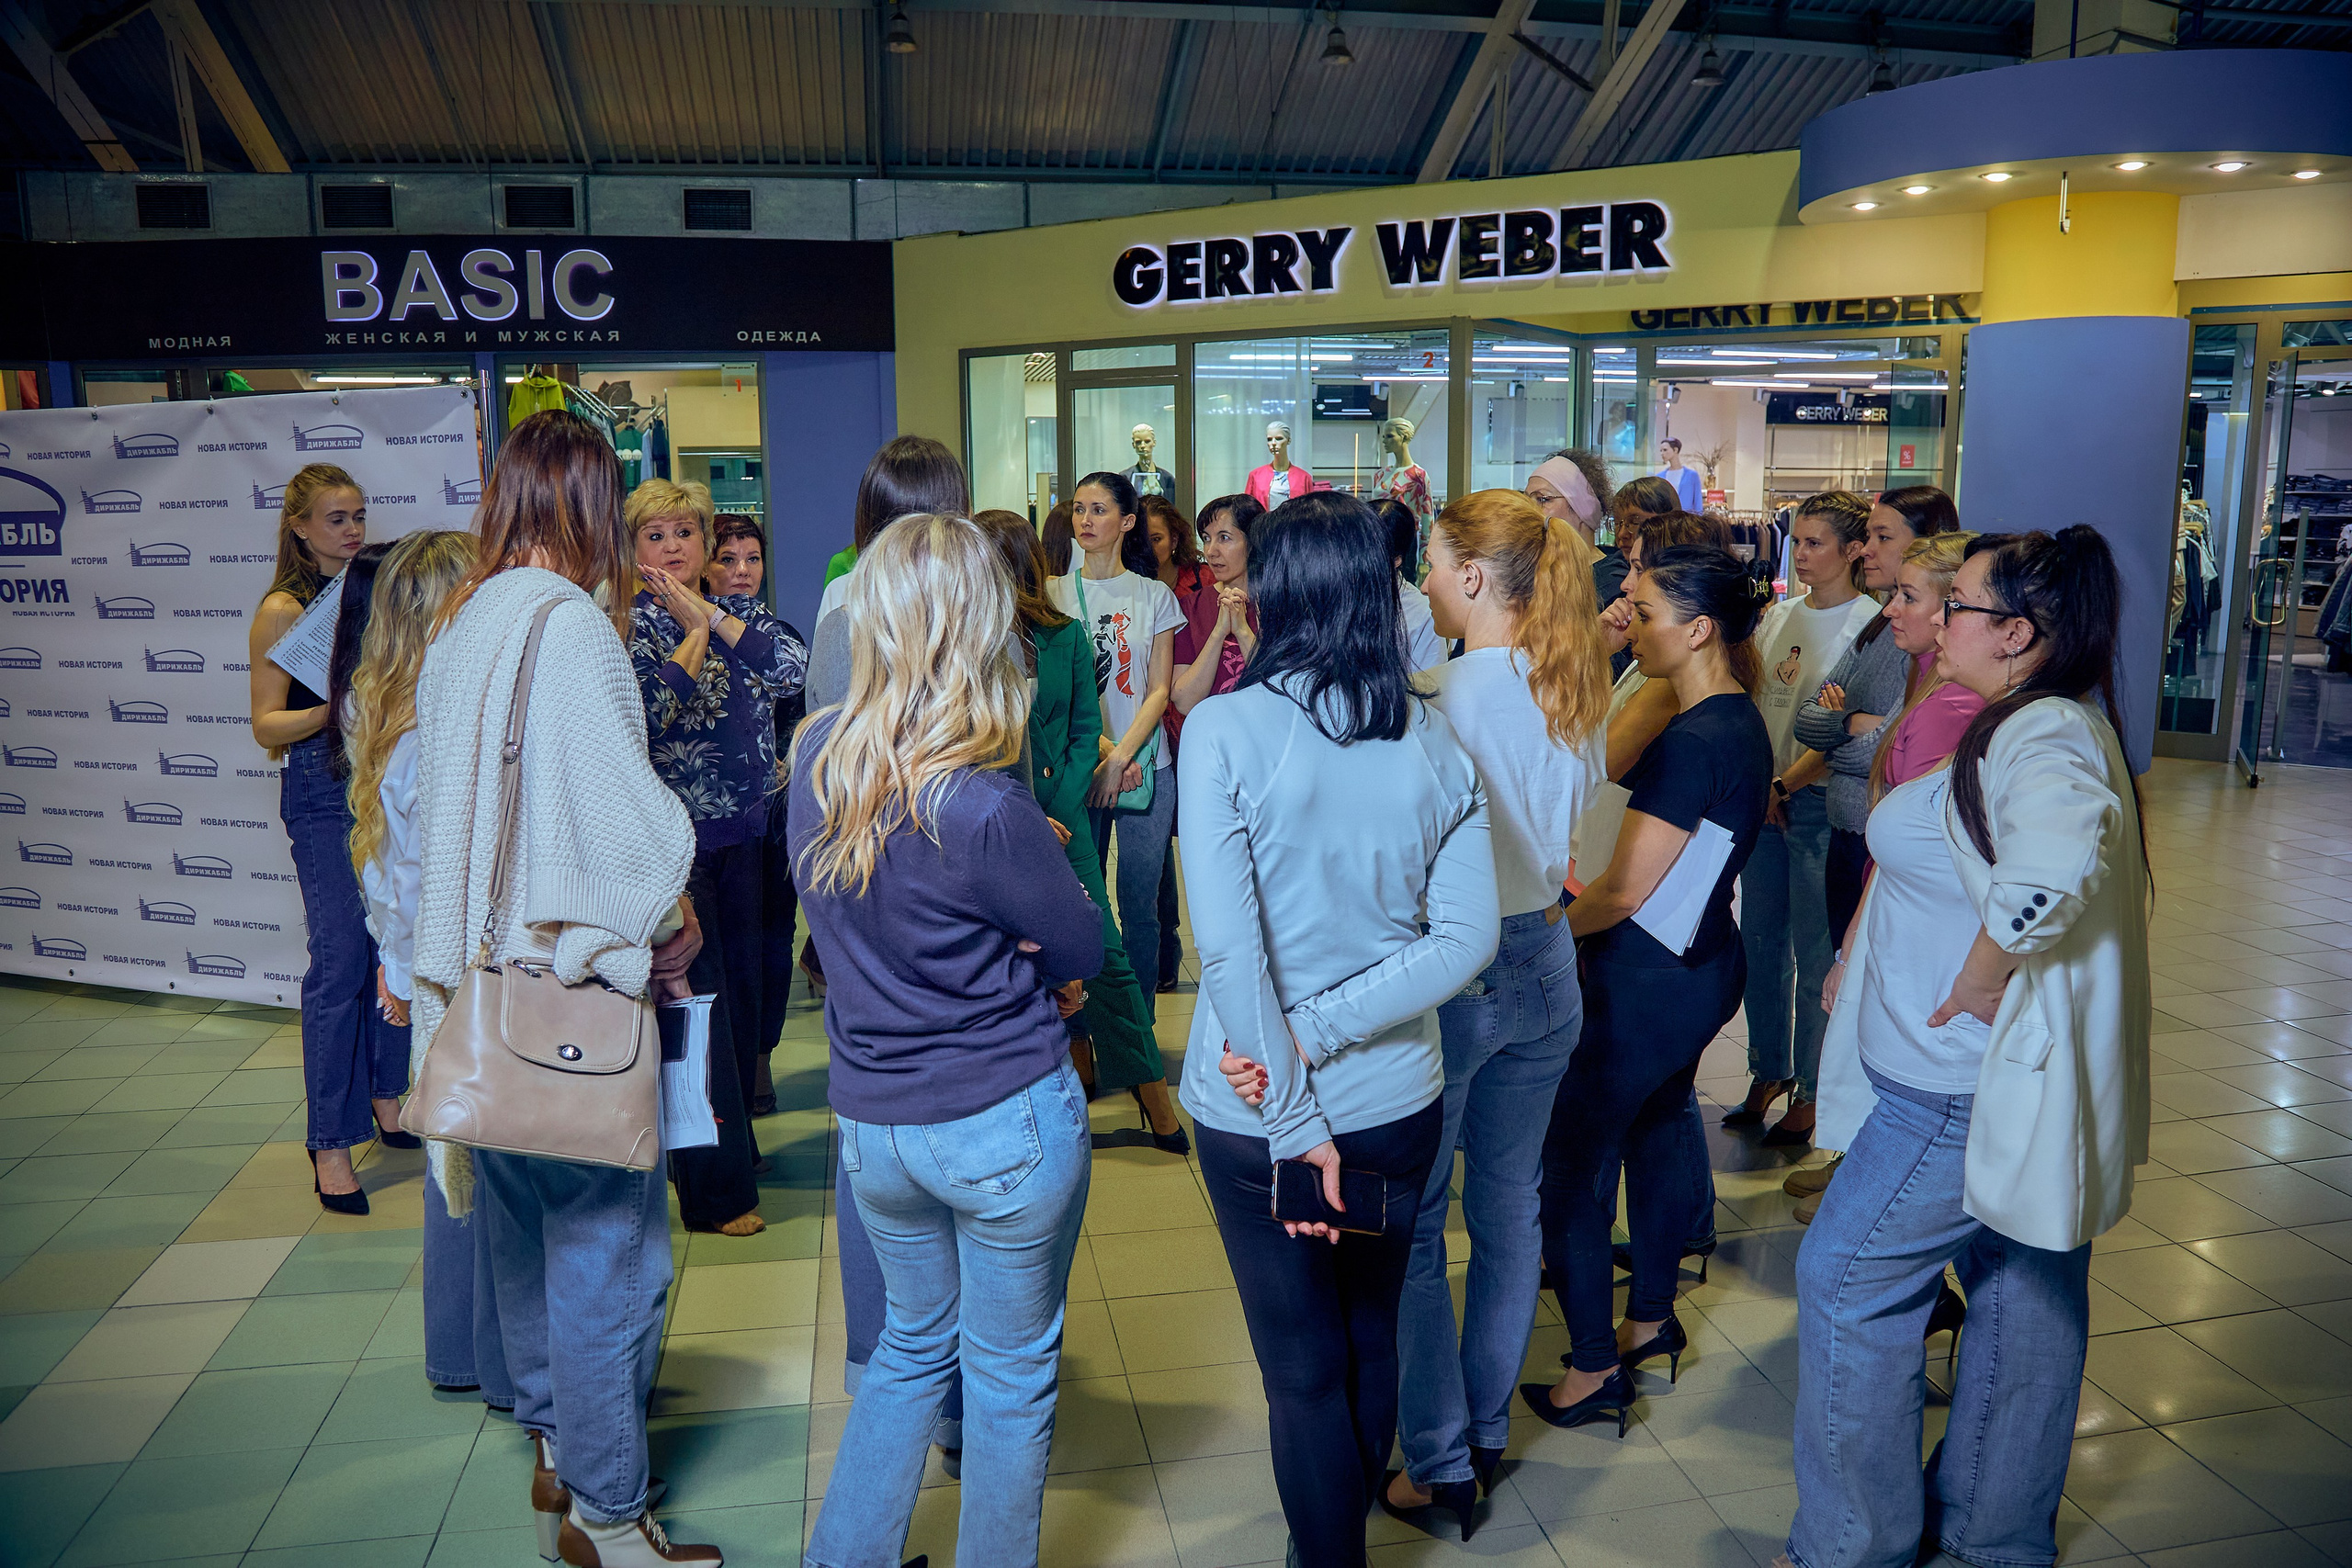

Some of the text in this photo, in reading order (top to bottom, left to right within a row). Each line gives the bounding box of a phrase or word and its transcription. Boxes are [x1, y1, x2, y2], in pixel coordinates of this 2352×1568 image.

[1113, 200, 1672, 307] GERRY WEBER
[322, 248, 616, 321] BASIC
[1631, 294, 1967, 330] GERRY WEBER
[148, 329, 822, 349] МОДНАЯ ЖЕНСКАЯ И МУЖСКАЯ ОДЕЖДА
[1423, 351, 1434, 368] 2
[735, 378, 741, 392] 1
[1795, 405, 1888, 422] GERRY WEBER
[306, 439, 361, 450] ДИРИЖАБЛЬ
[386, 434, 464, 446] НОВАЯ ИСТОРИЯ
[127, 446, 177, 457] ДИРИЖАБЛЬ
[198, 442, 268, 452] НОВАЯ ИСТОРИЯ
[28, 450, 92, 460] НОВАЯ ИСТОРИЯ
[159, 500, 229, 510] НОВАЯ ИСТОРИЯ
[265, 500, 285, 508] ДИР
[372, 495, 417, 504] ИСТОРИЯ
[95, 502, 140, 512] ДИРИЖАБЛЬ
[71, 557, 108, 566] ИСТОРИЯ
[141, 555, 189, 565] ДИРИЖАБЛЬ
[209, 555, 239, 564] НОВАЯ
[107, 608, 153, 618] ДИРИЖАБЛЬ
[173, 609, 243, 618] НОВАЯ ИСТОРИЯ
[59, 660, 123, 670] НОВАЯ ИСТОРИЯ
[156, 662, 203, 671] ДИРИЖАБЛЬ
[223, 663, 251, 671] НОВАЯ
[27, 709, 89, 719] НОВАЯ ИСТОРИЯ
[121, 713, 166, 723] ДИРИЖАБЛЬ
[186, 715, 214, 724] НОВАЯ
[14, 758, 56, 768] ДИРИЖАБЛЬ
[74, 760, 138, 772] НОВАЯ ИСТОРИЯ
[170, 766, 217, 776] ДИРИЖАБЛЬ
[236, 769, 265, 778] НОВАЯ
[42, 807, 104, 818] НОВАЯ ИСТОРИЯ
[136, 814, 181, 825] ДИРИЖАБЛЬ
[200, 818, 268, 829] НОВАЯ ИСТОРИЯ
[29, 854, 72, 865] ДИРИЖАБЛЬ
[89, 858, 153, 871] НОВАЯ ИСТОРИЯ
[185, 867, 232, 878] ДИРИЖАБЛЬ
[251, 872, 298, 883] НОВАЯ ИСТ
[57, 903, 119, 916] НОВАЯ ИСТОРИЯ
[150, 912, 195, 924] ДИРИЖАБЛЬ
[213, 918, 280, 931] НОВАЯ ИСТОРИЯ
[42, 949, 85, 960] ДИРИЖАБЛЬ
[103, 954, 166, 967] НОВАЯ ИСТОРИЯ
[198, 965, 244, 977] ДИРИЖАБЛЬ
[264, 972, 291, 982] НОВАЯ
